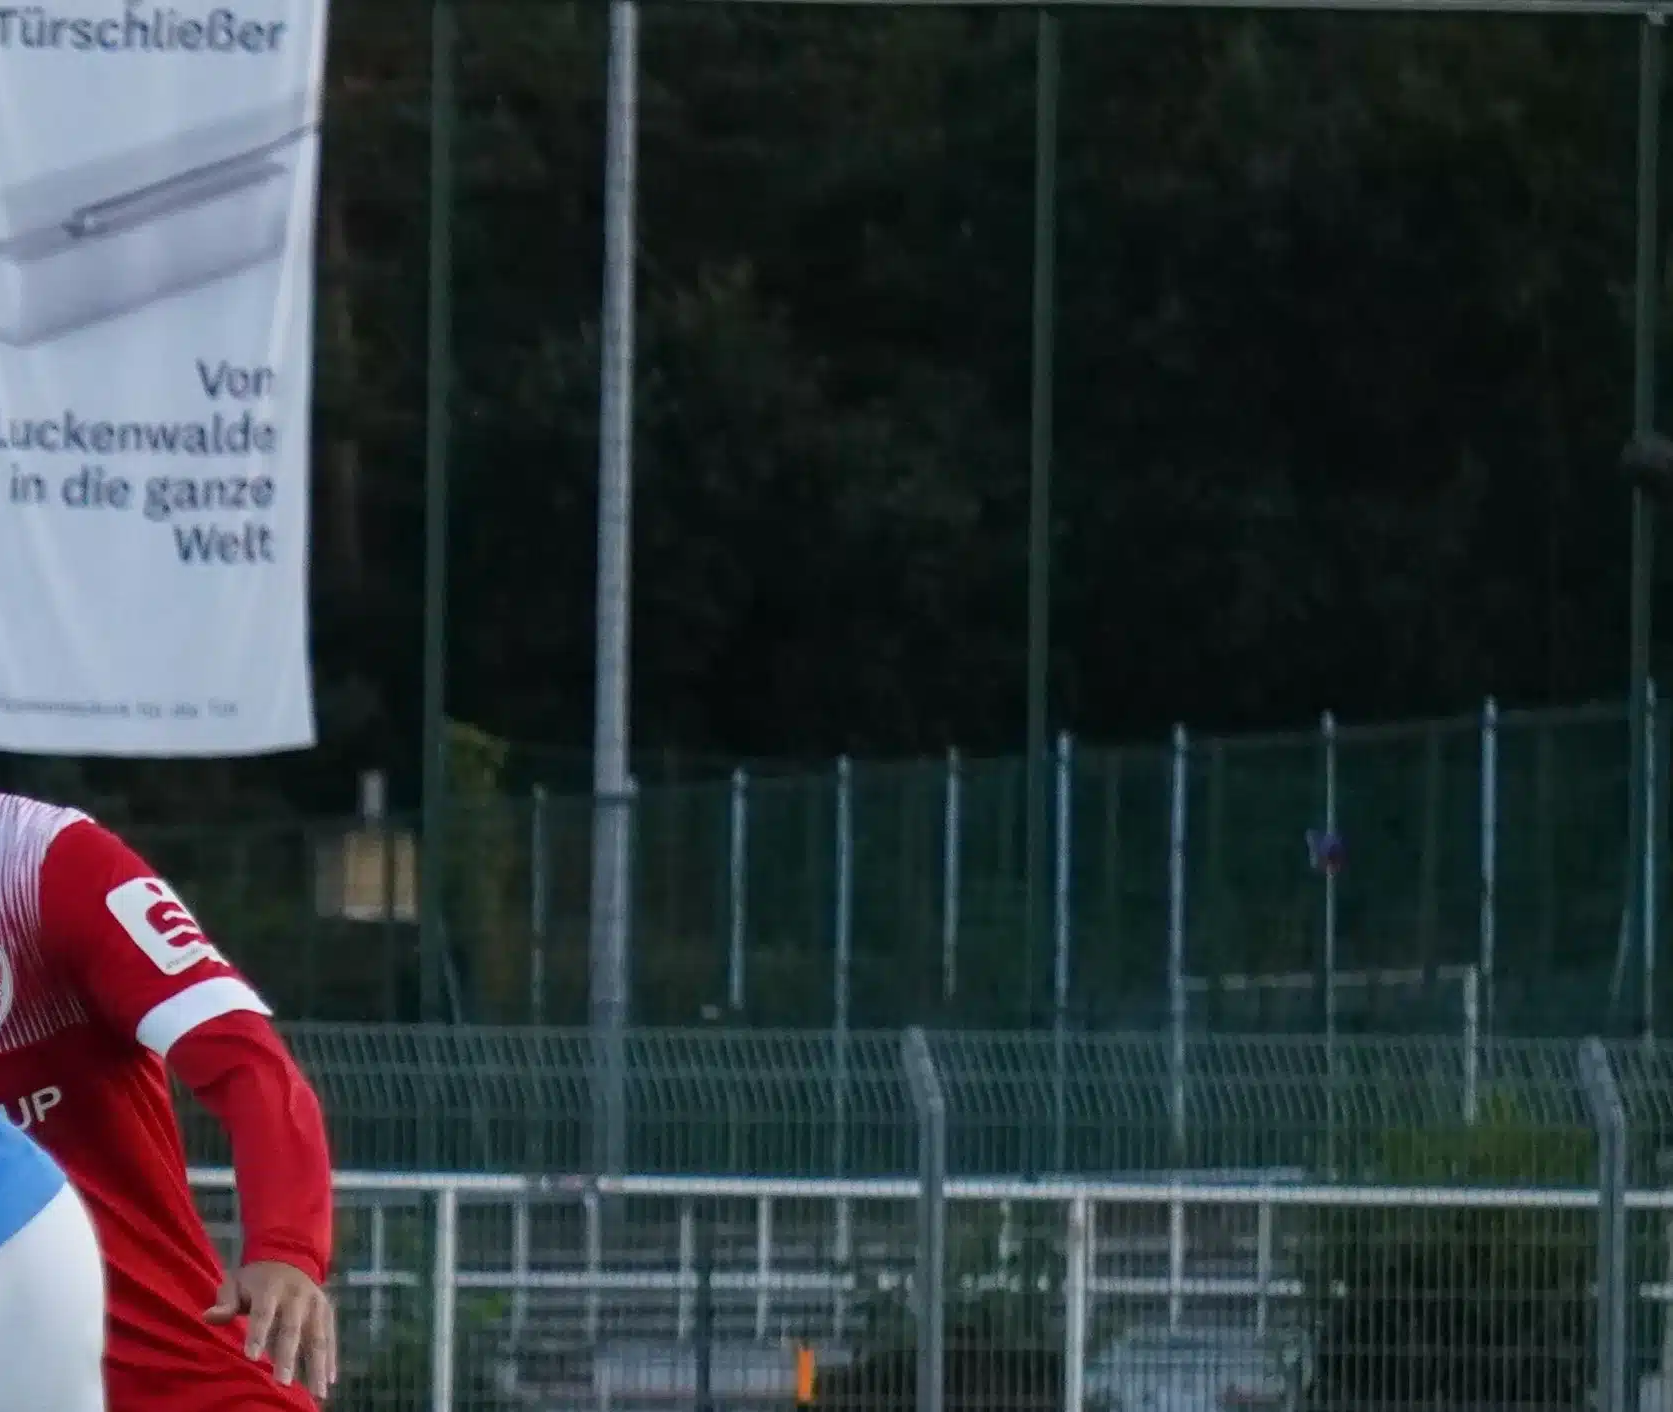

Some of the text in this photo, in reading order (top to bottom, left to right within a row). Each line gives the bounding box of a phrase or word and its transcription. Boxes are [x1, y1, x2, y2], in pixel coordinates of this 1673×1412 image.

[196, 358, 274, 400] Von
[9, 463, 275, 522] in die ganze
[173, 521, 274, 564] Welt
